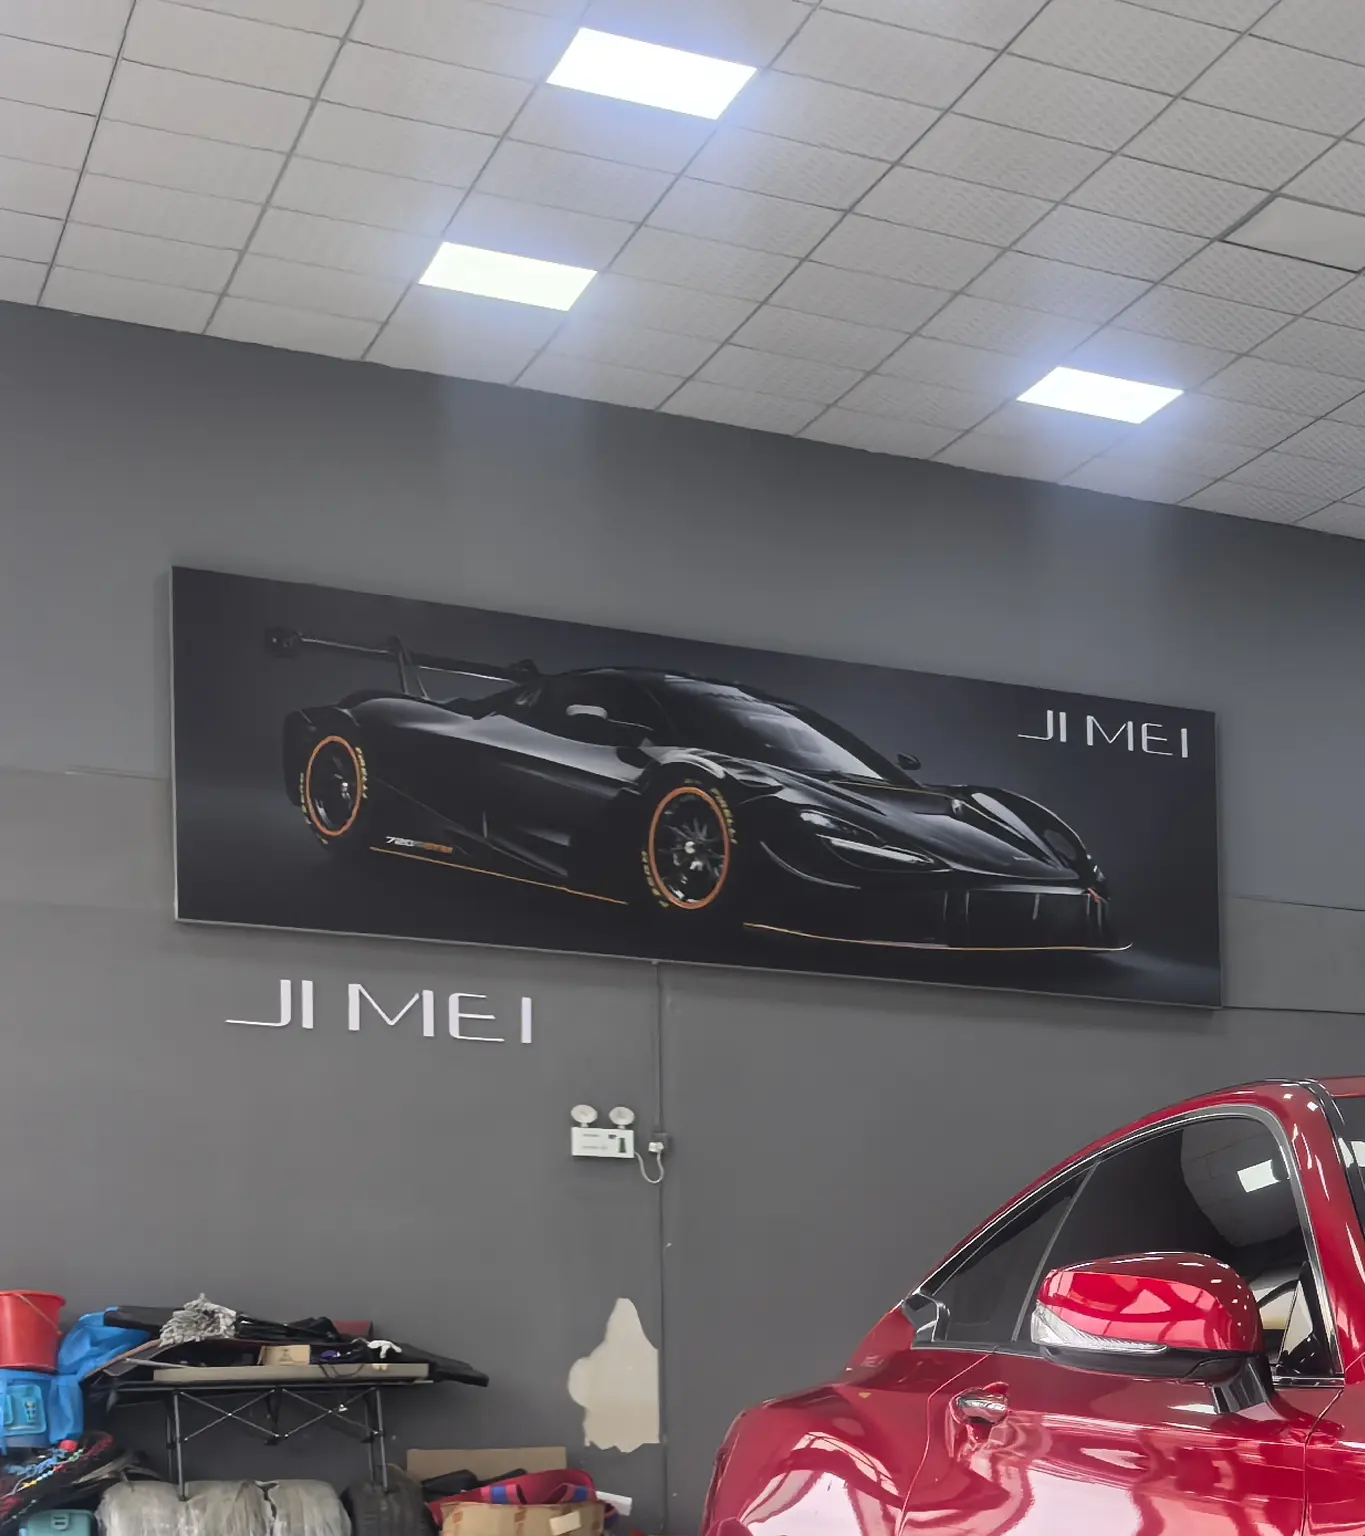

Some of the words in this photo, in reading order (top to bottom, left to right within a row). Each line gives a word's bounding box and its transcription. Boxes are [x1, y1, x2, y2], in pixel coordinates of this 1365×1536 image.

[1018, 710, 1067, 743] JI
[1086, 715, 1189, 758] MEI
[224, 979, 314, 1029] JI
[348, 983, 532, 1044] MEI
